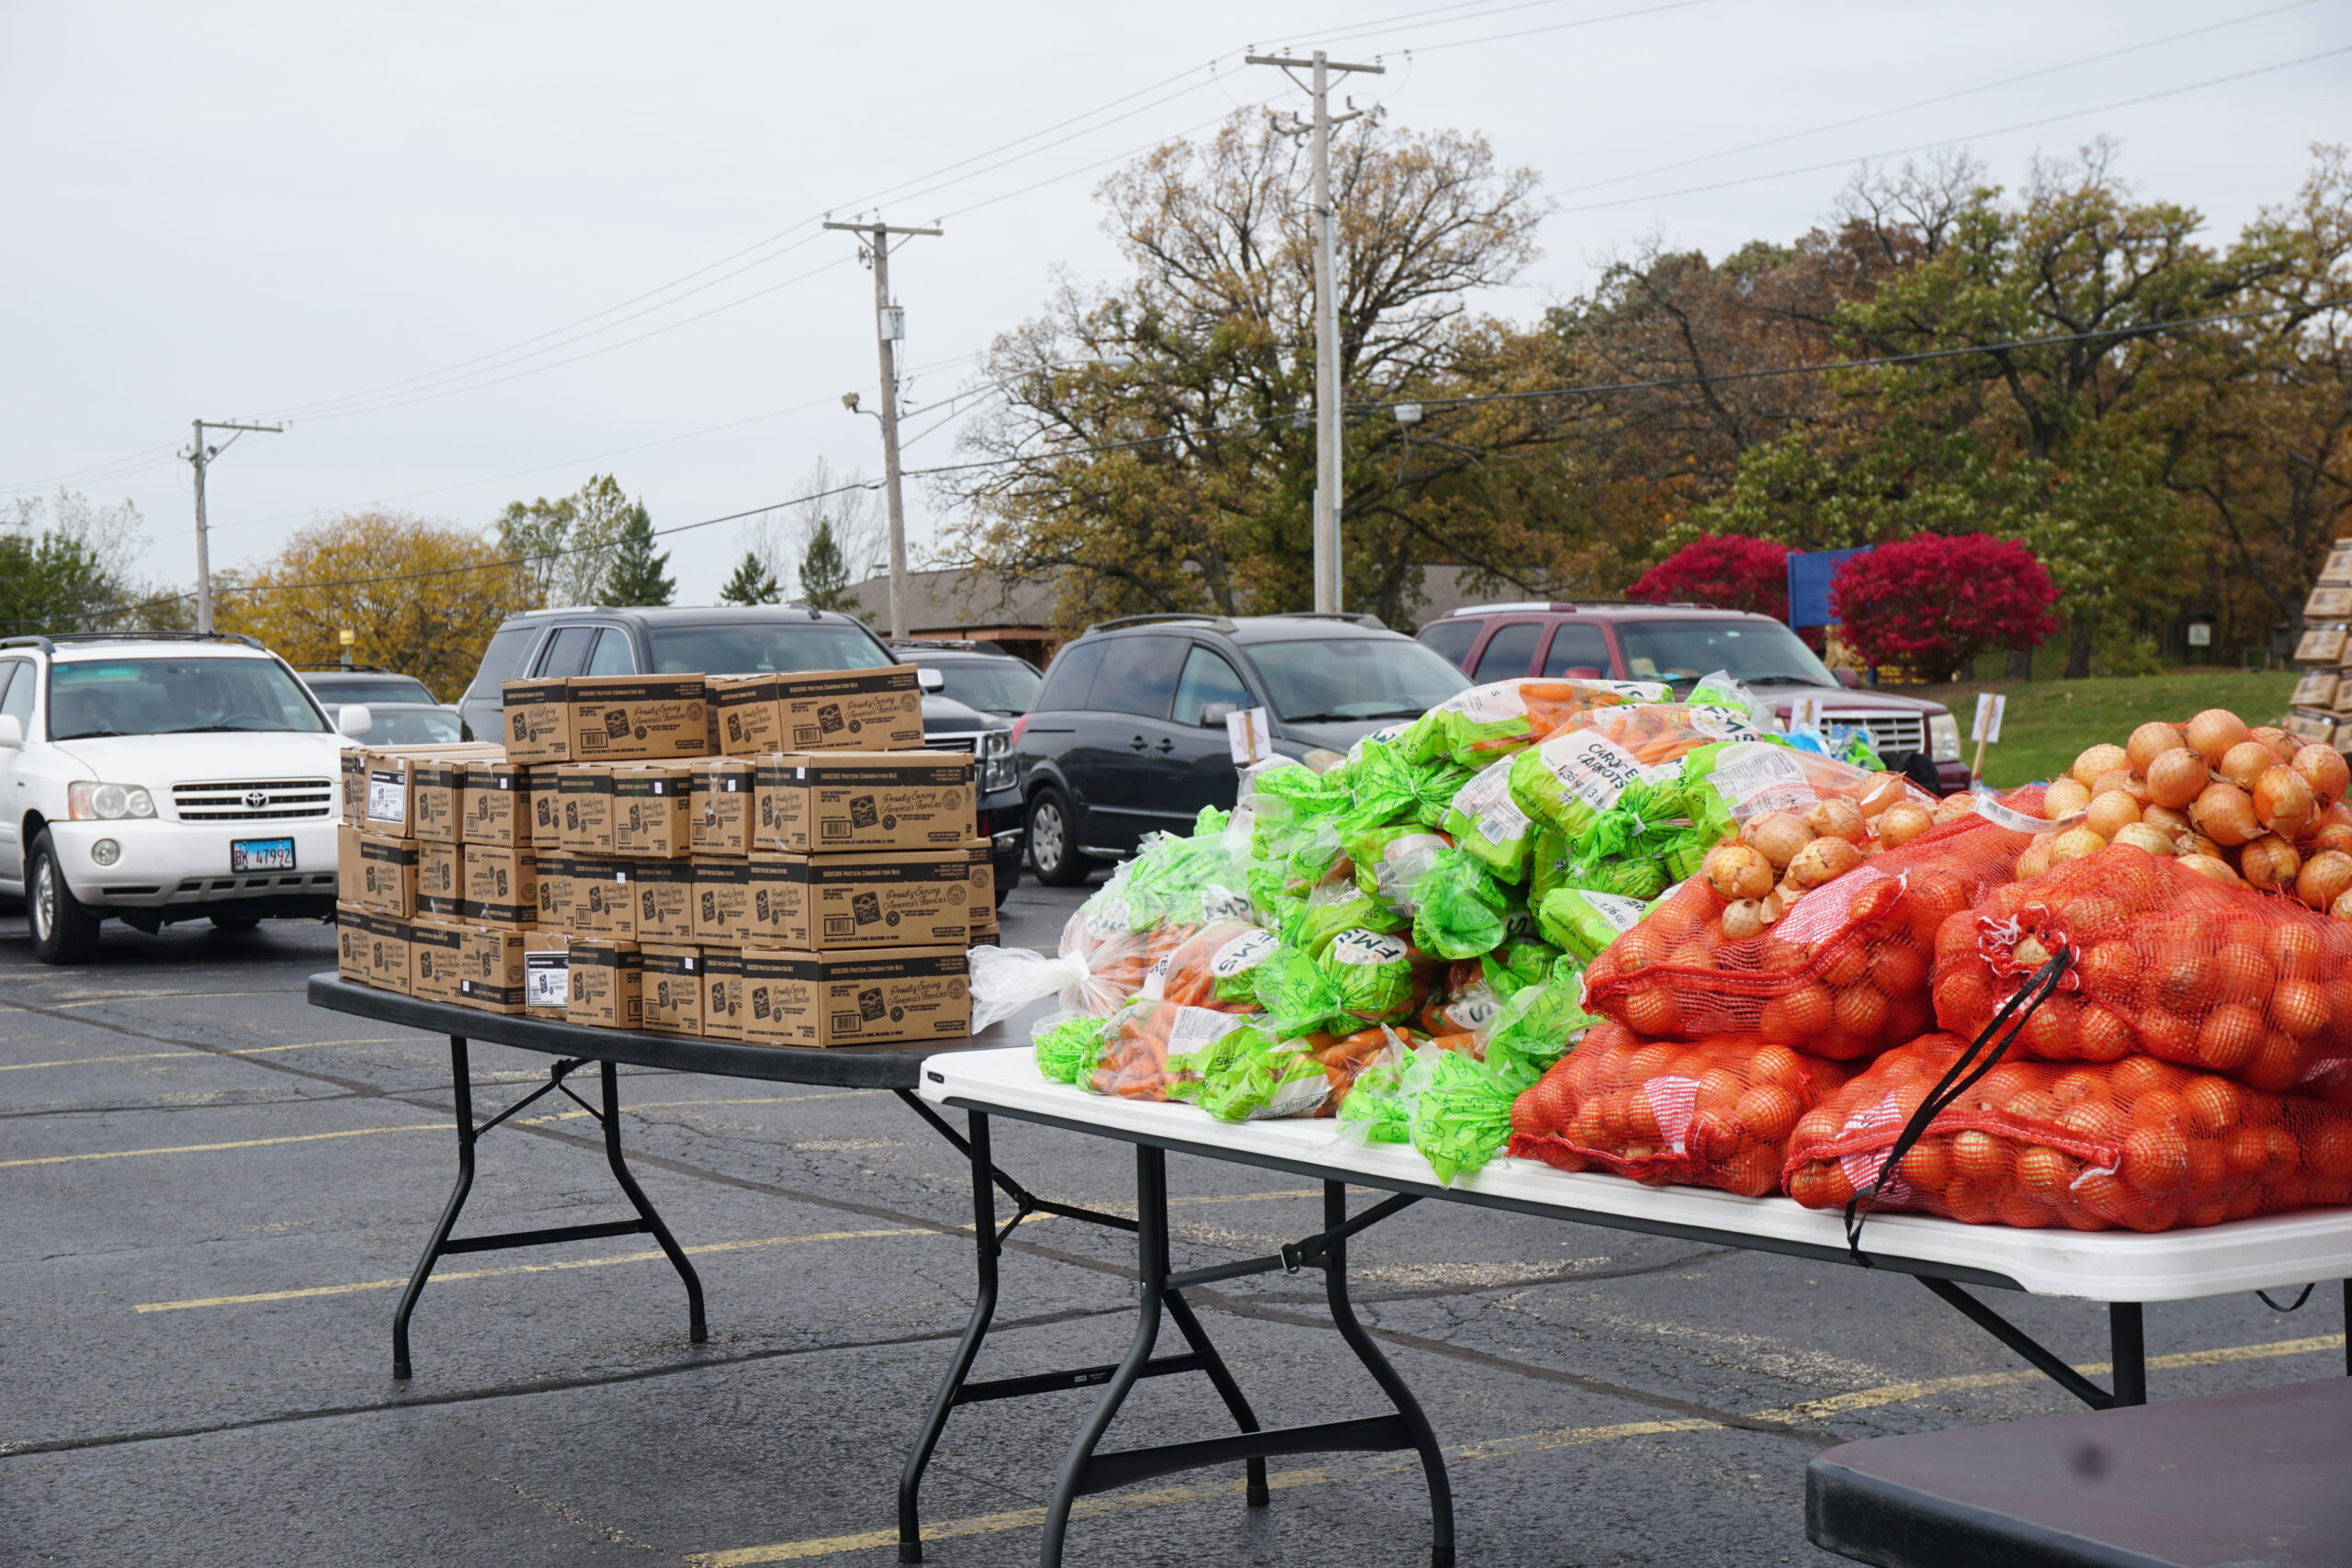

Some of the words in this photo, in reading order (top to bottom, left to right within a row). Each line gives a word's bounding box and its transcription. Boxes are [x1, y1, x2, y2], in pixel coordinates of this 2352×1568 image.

[884, 793, 911, 803] Proudly
[911, 790, 936, 802] Serving
[915, 800, 942, 810] Families
[256, 848, 291, 865] 47992
[886, 890, 915, 900] Proudly
[915, 886, 940, 897] Serving
[919, 895, 946, 906] Families
[891, 985, 917, 995] Proudly
[917, 981, 941, 991] Serving
[921, 991, 947, 1000] Families
